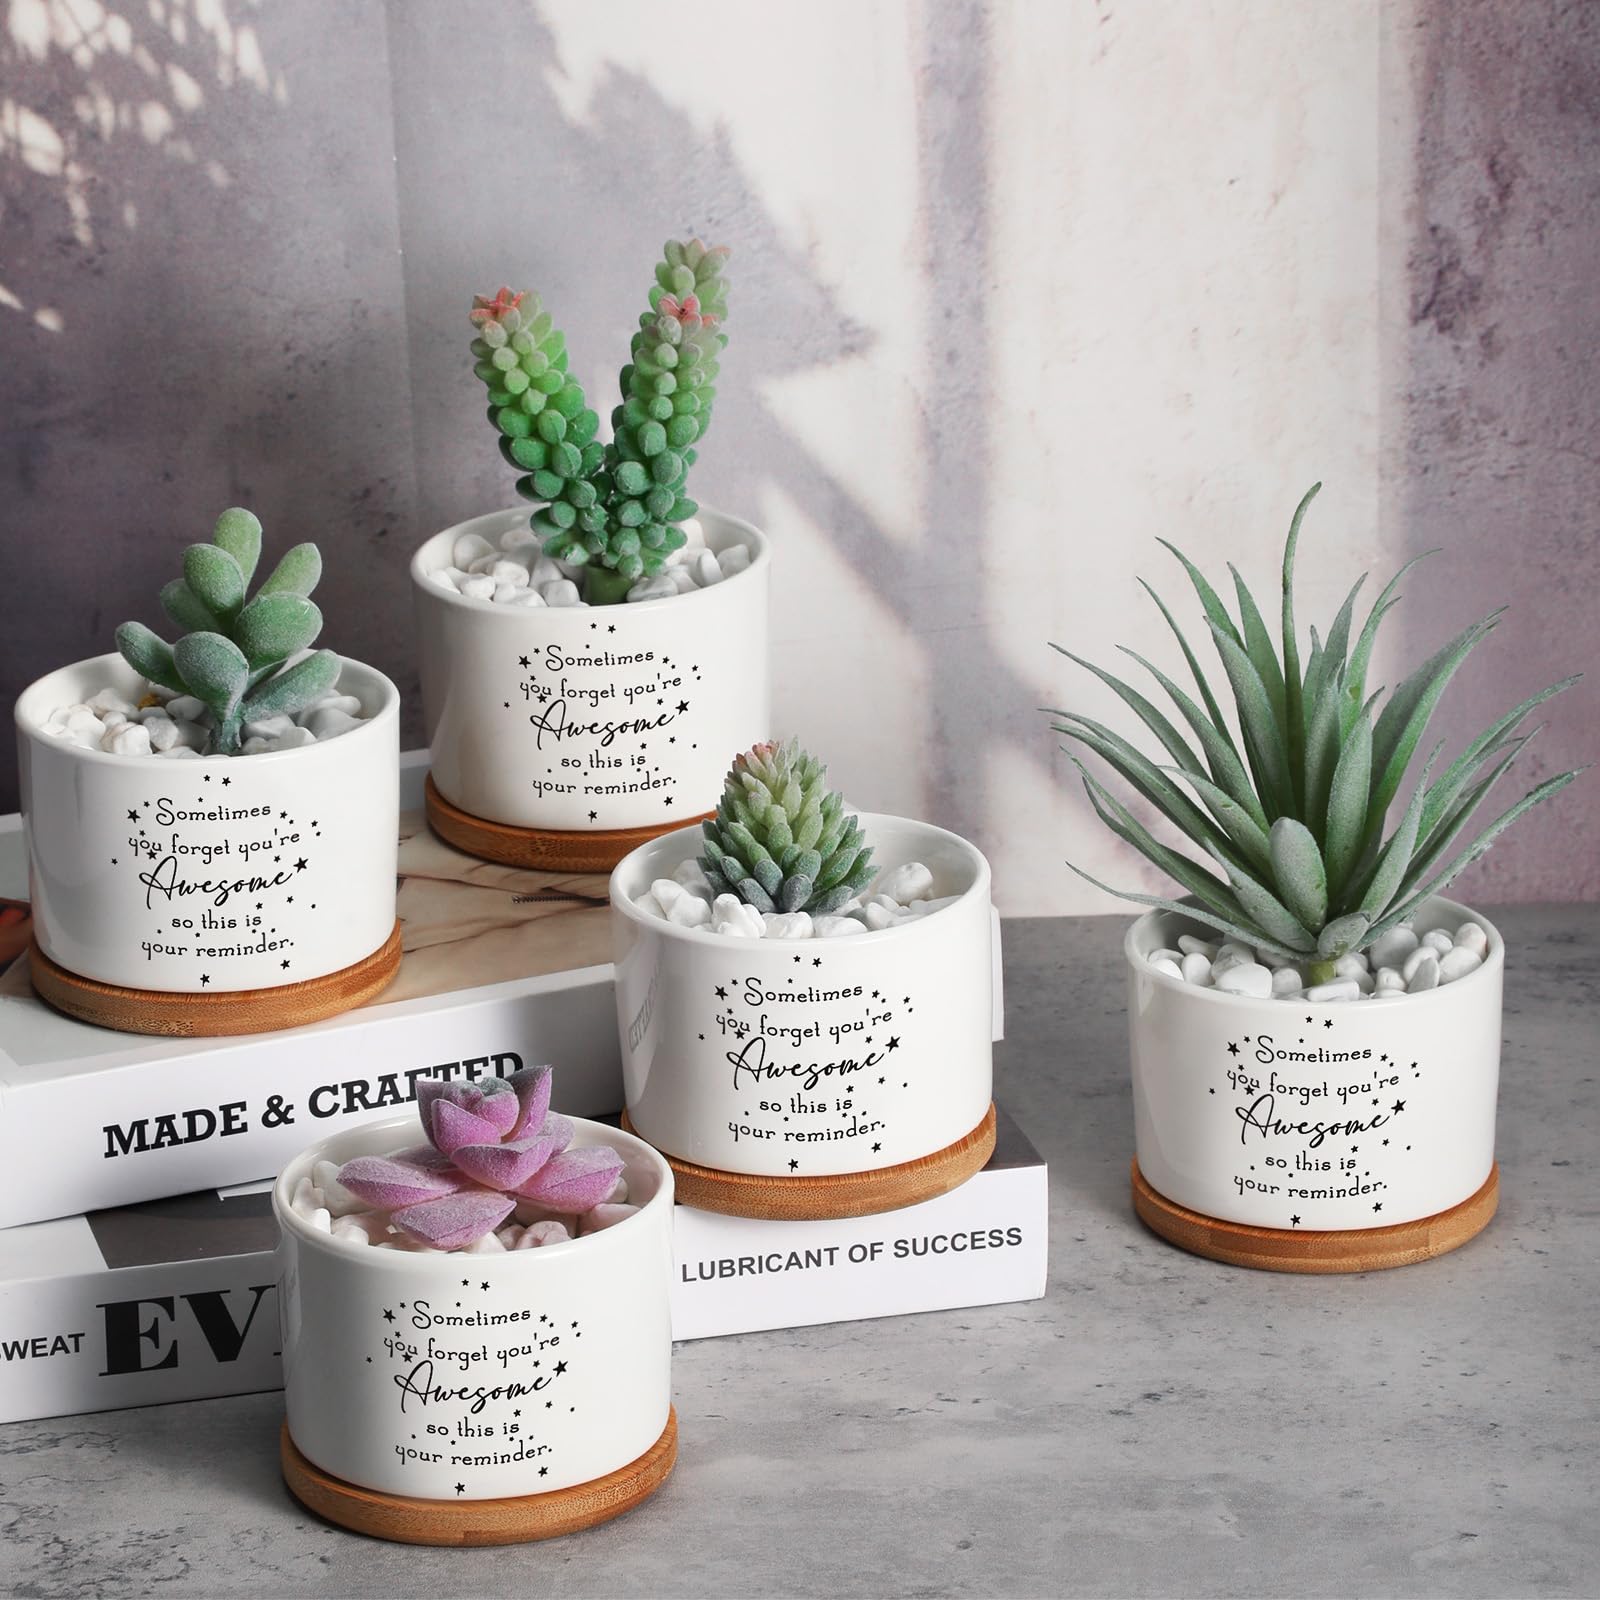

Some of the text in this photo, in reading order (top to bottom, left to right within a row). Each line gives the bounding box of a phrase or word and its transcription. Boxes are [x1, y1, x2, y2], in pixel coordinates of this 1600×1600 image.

[546, 645, 653, 671] Sometimes
[520, 673, 681, 707] you forget you're
[530, 699, 675, 750] Awesome
[561, 749, 645, 768] so this is
[533, 773, 676, 798] your reminder.
[156, 797, 270, 826] Sometimes
[129, 828, 299, 864] you forget you're
[139, 856, 293, 910] Awesome
[172, 909, 261, 929] so this is
[142, 931, 293, 960] your reminder.
[744, 977, 862, 1006] Sometimes
[717, 1009, 892, 1047] you forget you're
[1256, 1035, 1371, 1063] Sometimes
[726, 1036, 885, 1093] Awesome
[1226, 1070, 1399, 1105] you forget you're
[760, 1093, 852, 1113] so this is
[102, 1101, 249, 1159] MADE
[261, 1094, 295, 1129] &
[729, 1115, 885, 1142] your reminder.
[1235, 1094, 1389, 1153] Awesome
[1265, 1150, 1356, 1171] so this is
[1234, 1174, 1387, 1198] your reminder.
[681, 1227, 1023, 1283] LUBRICANT OF SUCCESS
[412, 1300, 530, 1329] Sometimes
[96, 1284, 282, 1377] EV
[0, 1333, 86, 1361] WEAT
[384, 1333, 559, 1370] you forget you're
[394, 1360, 552, 1417] Awesome
[427, 1416, 519, 1437] so this is
[395, 1439, 552, 1465] your reminder.
